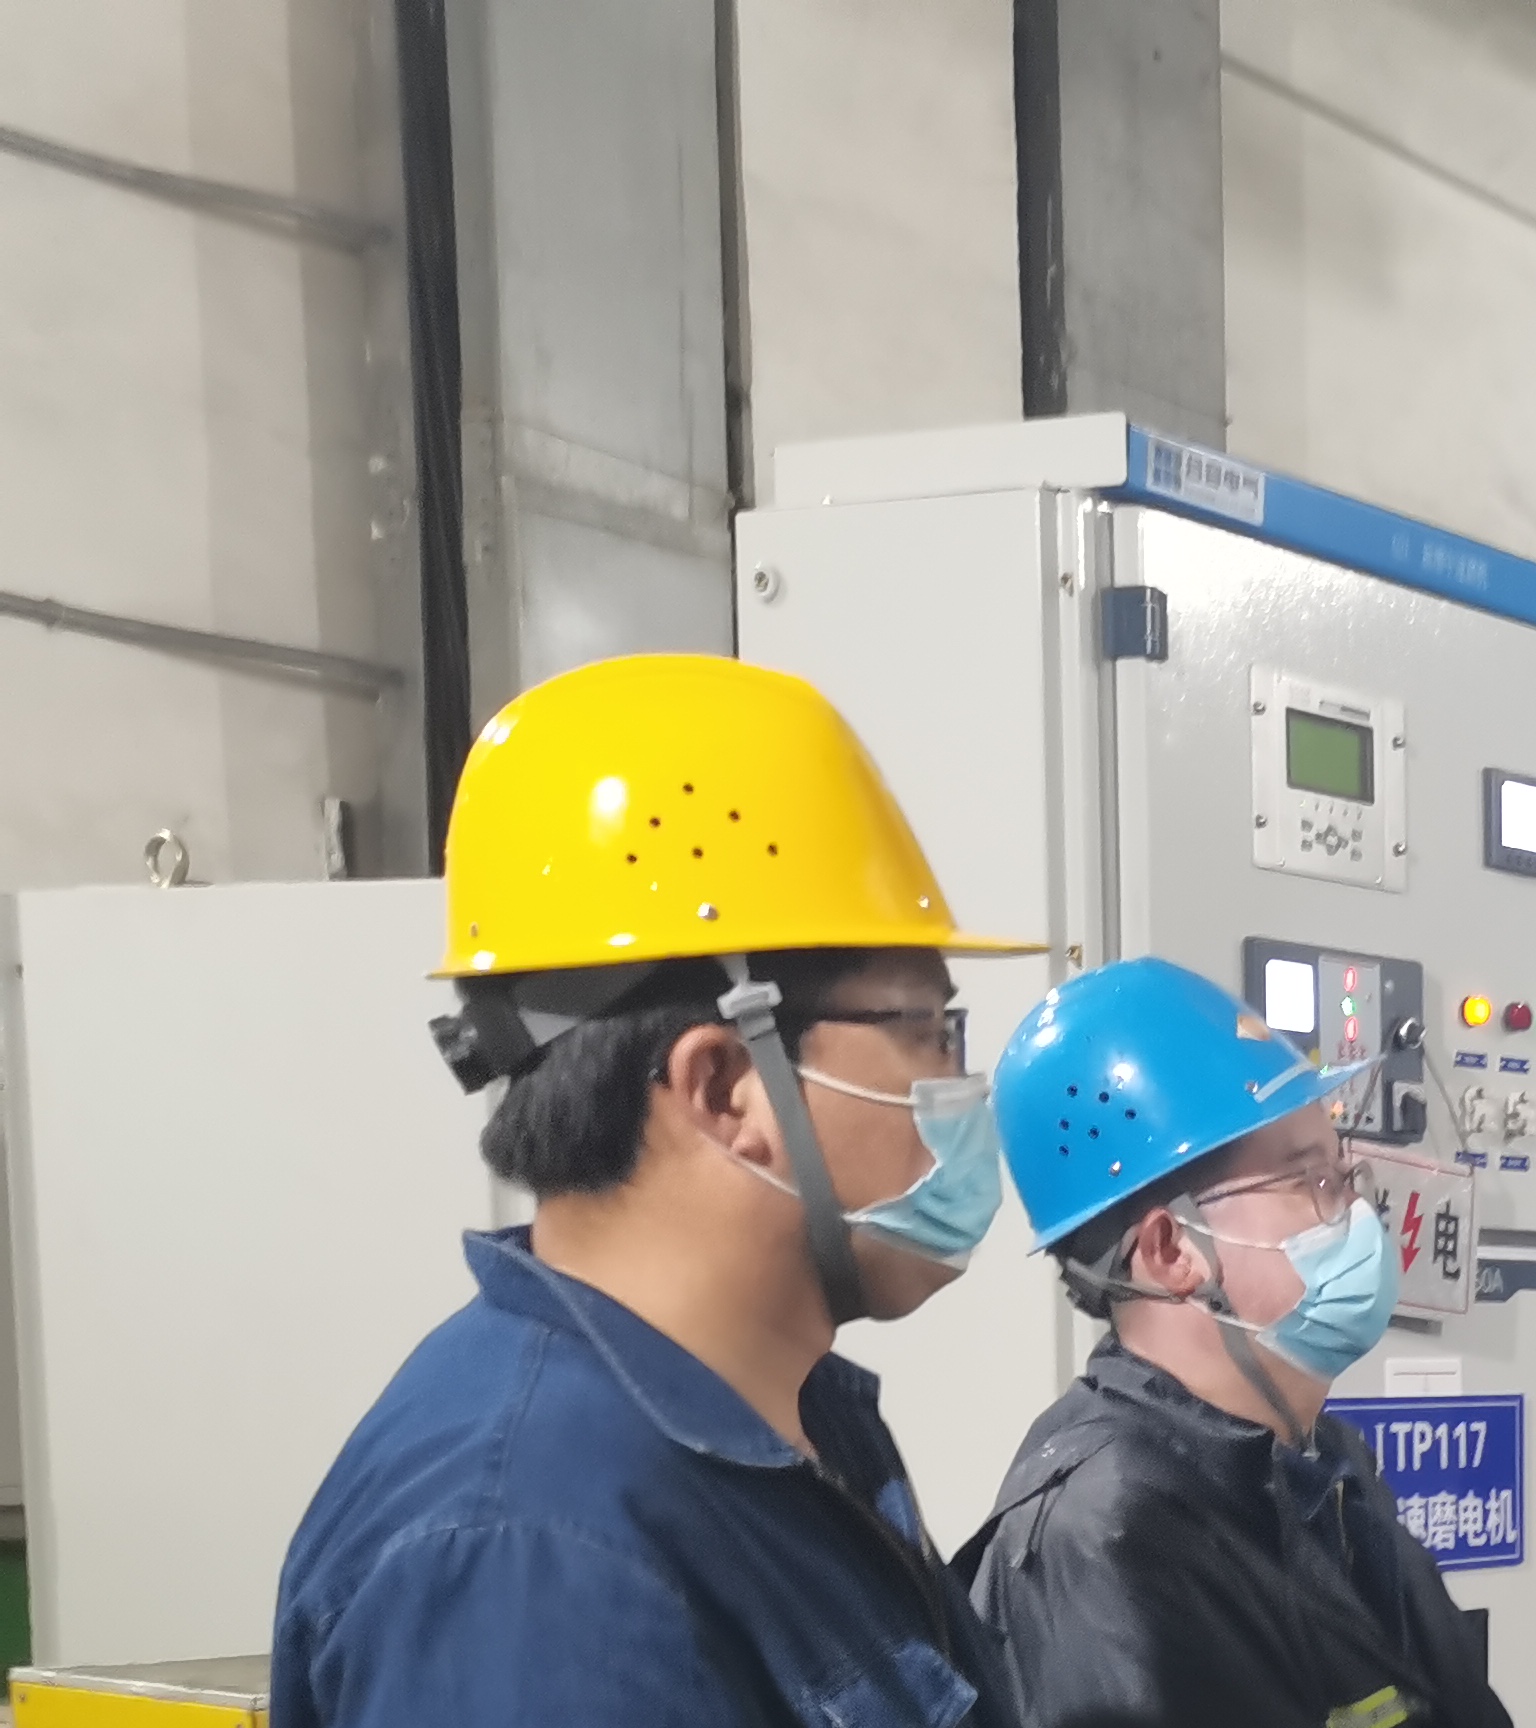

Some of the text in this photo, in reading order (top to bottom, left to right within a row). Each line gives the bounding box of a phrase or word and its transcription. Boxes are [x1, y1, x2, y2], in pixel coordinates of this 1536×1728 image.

[1359, 1420, 1487, 1476] ITP117
[1397, 1486, 1518, 1551] 速磨电机
